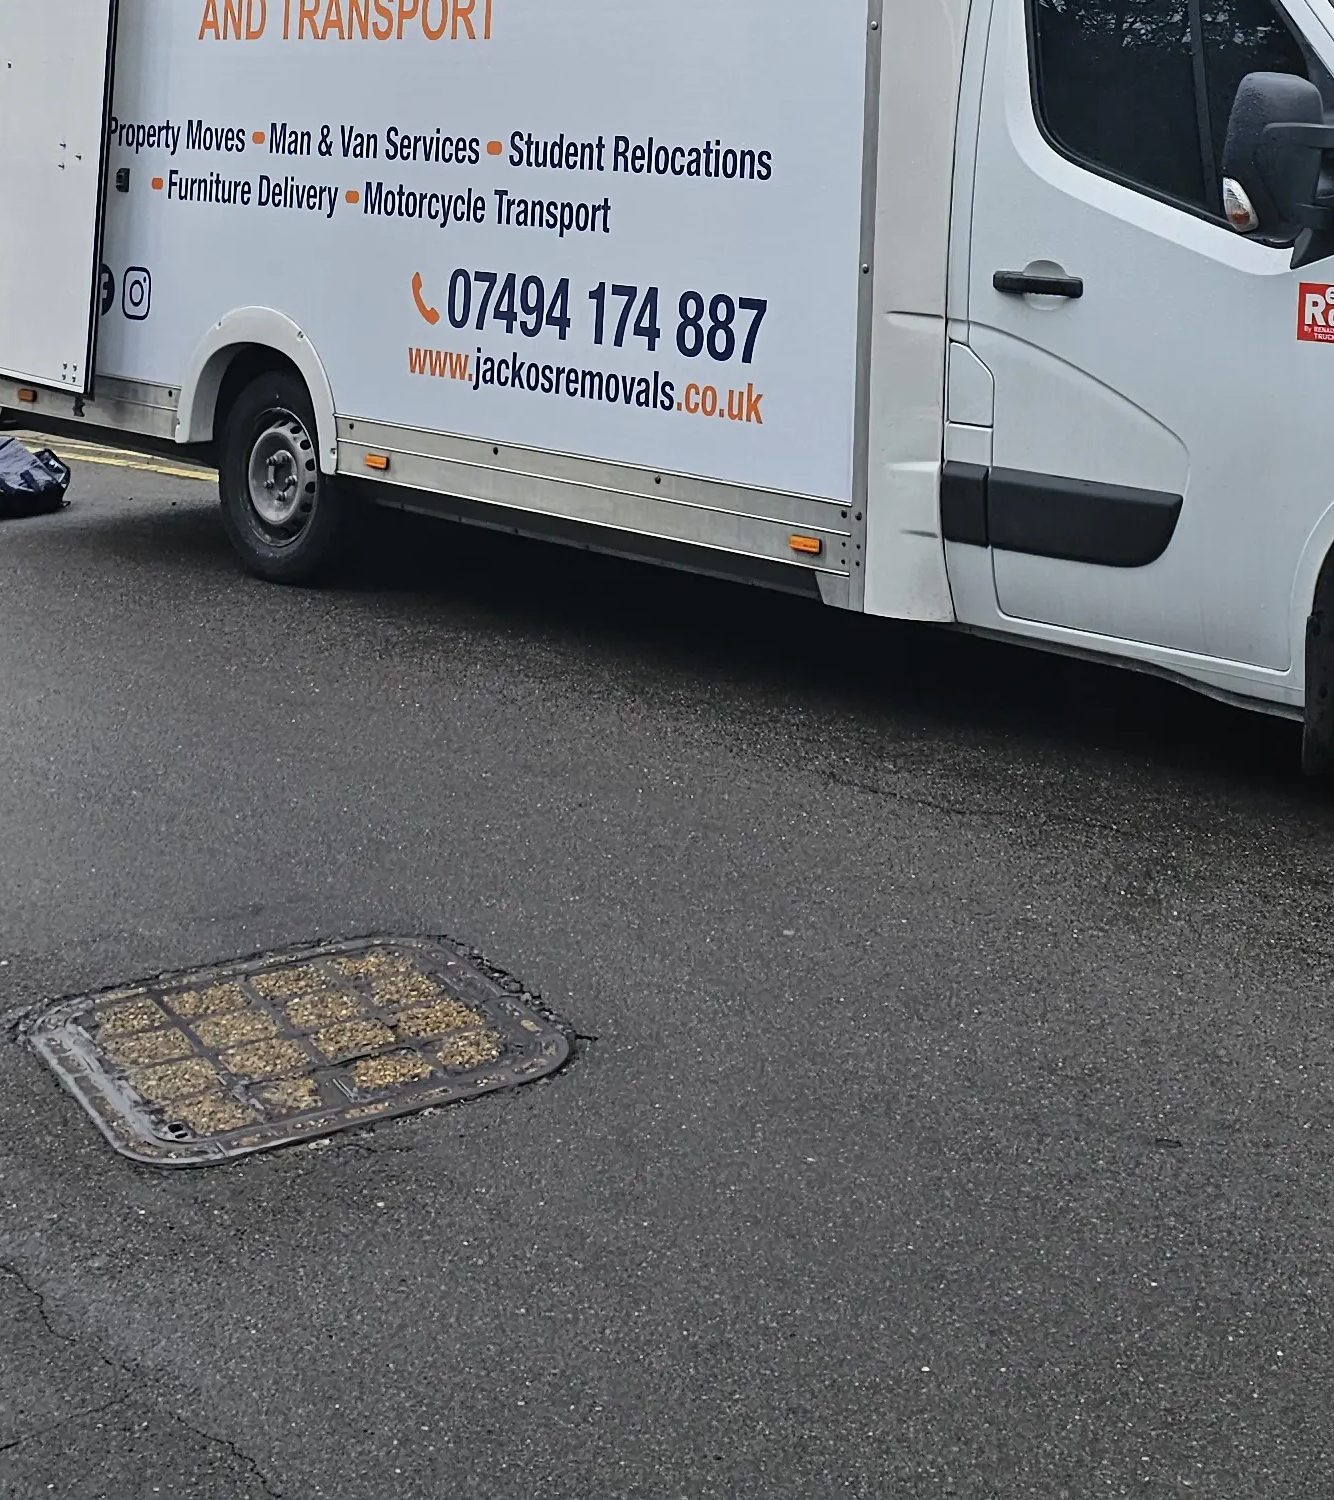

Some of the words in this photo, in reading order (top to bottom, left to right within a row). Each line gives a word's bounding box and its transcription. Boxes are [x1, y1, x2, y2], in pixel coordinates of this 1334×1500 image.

[111, 116, 181, 156] Property
[186, 120, 246, 153] Moves
[269, 122, 312, 156] Man
[318, 124, 333, 157] &
[340, 125, 378, 159] Van
[385, 126, 481, 165] Services
[509, 130, 605, 172] Student
[613, 135, 773, 181] Relocations
[167, 169, 252, 206] Furniture
[258, 174, 339, 219] Delivery
[363, 181, 486, 229] Motorcycle
[494, 189, 611, 238] Transport
[447, 268, 571, 341] 07494
[588, 281, 661, 352] 174
[676, 290, 768, 364] 887
[408, 346, 763, 425] www.jackosremovals.co.uk
